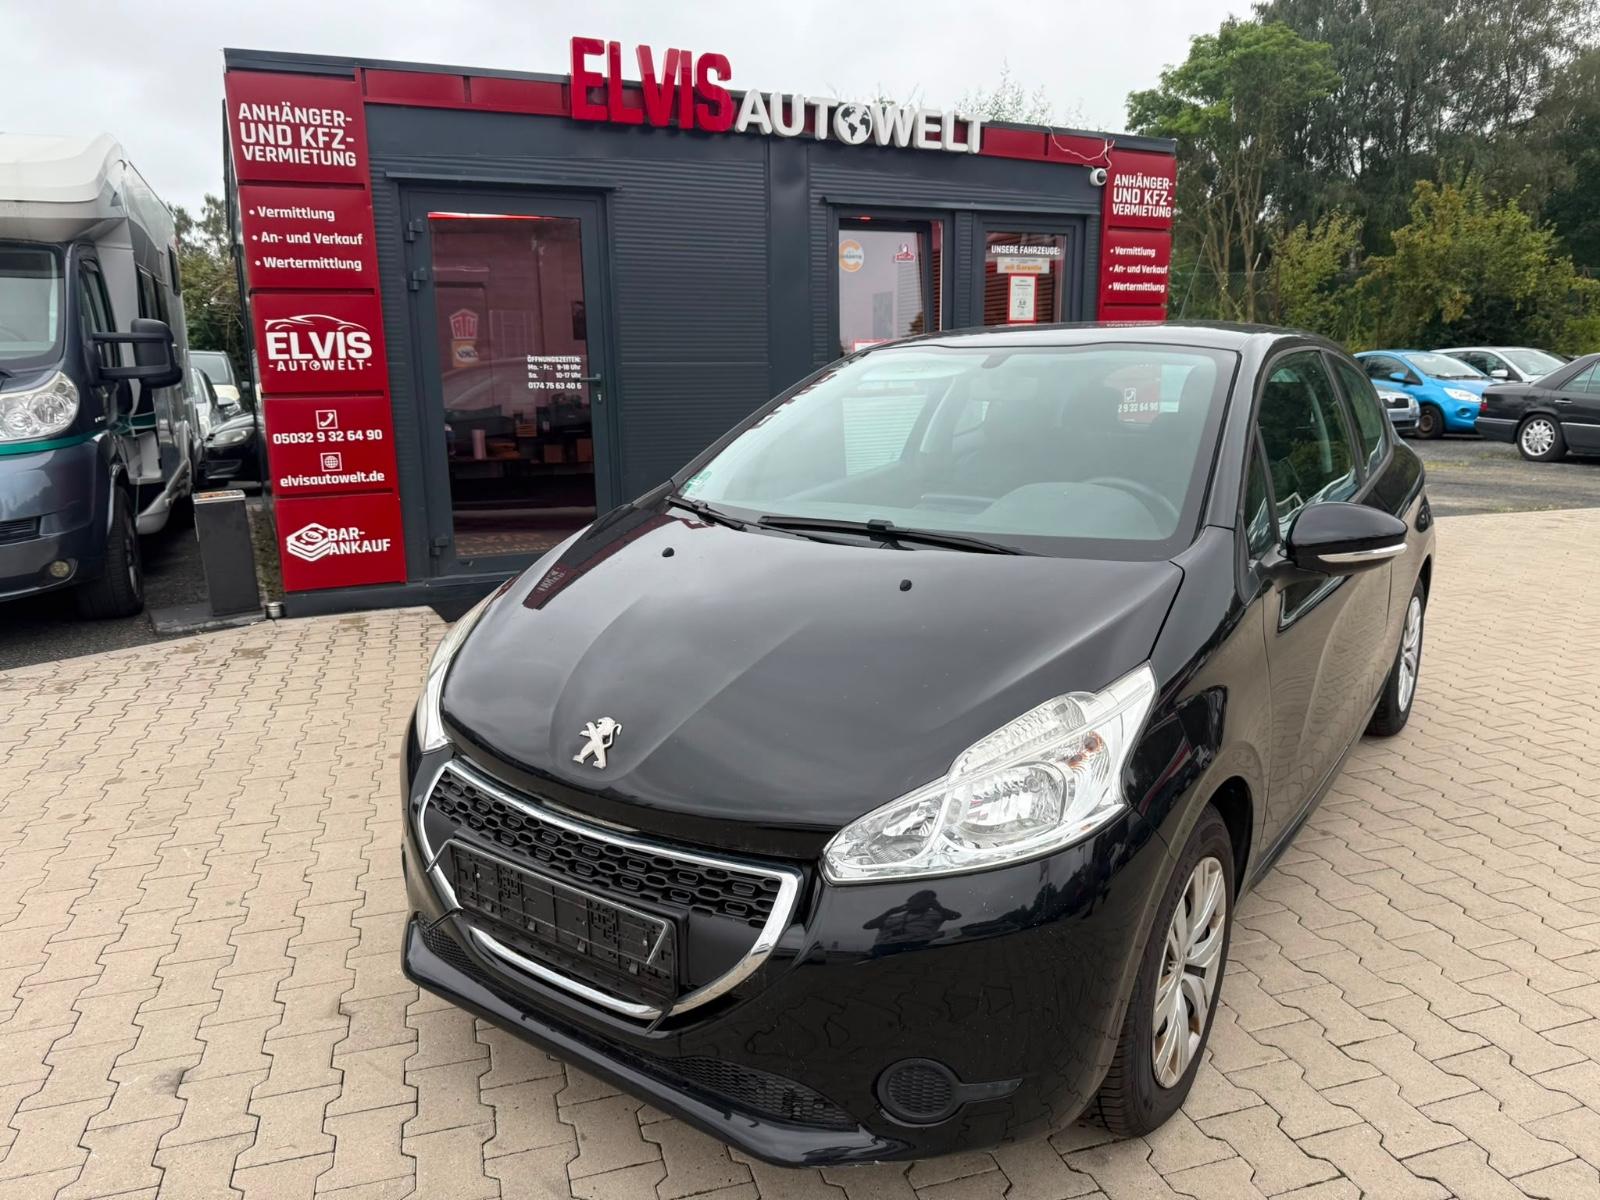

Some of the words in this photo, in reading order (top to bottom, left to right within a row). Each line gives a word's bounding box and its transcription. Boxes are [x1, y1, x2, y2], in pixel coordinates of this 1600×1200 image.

[569, 36, 736, 132] ELVIS
[734, 88, 990, 154] AUTOWELT
[238, 101, 353, 127] ANHÄNGER-
[240, 121, 293, 146] UND
[300, 126, 355, 150] KFZ-
[241, 145, 357, 167] VERMIETUNG
[1113, 172, 1173, 190] ANHÄNGER-
[1113, 187, 1141, 204] UND
[1143, 190, 1173, 206] KFZ-
[257, 205, 336, 222] Vermittlung
[1112, 203, 1172, 218] VERMIETUNG
[261, 231, 284, 243] An-
[286, 232, 312, 244] und
[314, 232, 364, 246] Verkauf
[991, 244, 1019, 254] UNSERE
[1019, 245, 1061, 256] FAHRZEUGE:
[1114, 245, 1156, 258] Vermittlung
[263, 255, 363, 272] Wertermittlung
[1113, 264, 1127, 274] An-
[1127, 264, 1141, 274] und
[1141, 265, 1169, 275] Verkauf
[1112, 281, 1166, 294] Wertermittlung
[265, 331, 372, 361] ELVIS
[527, 354, 582, 363] ÖFFNUNGSZEITEN:
[555, 371, 570, 379] 10-17
[570, 371, 582, 379] Uhr
[528, 381, 545, 389] 0174
[545, 381, 555, 389] 75
[555, 381, 565, 390] 63
[565, 381, 576, 390] 40
[576, 381, 582, 390] 6
[272, 431, 314, 445] 05032
[316, 430, 324, 443] 9
[327, 430, 344, 443] 32
[347, 429, 364, 442] 64
[366, 429, 383, 441] 90
[279, 470, 385, 488] elvisautowelt.de
[327, 528, 366, 542] BAR-
[329, 539, 391, 556] ANKAUF
